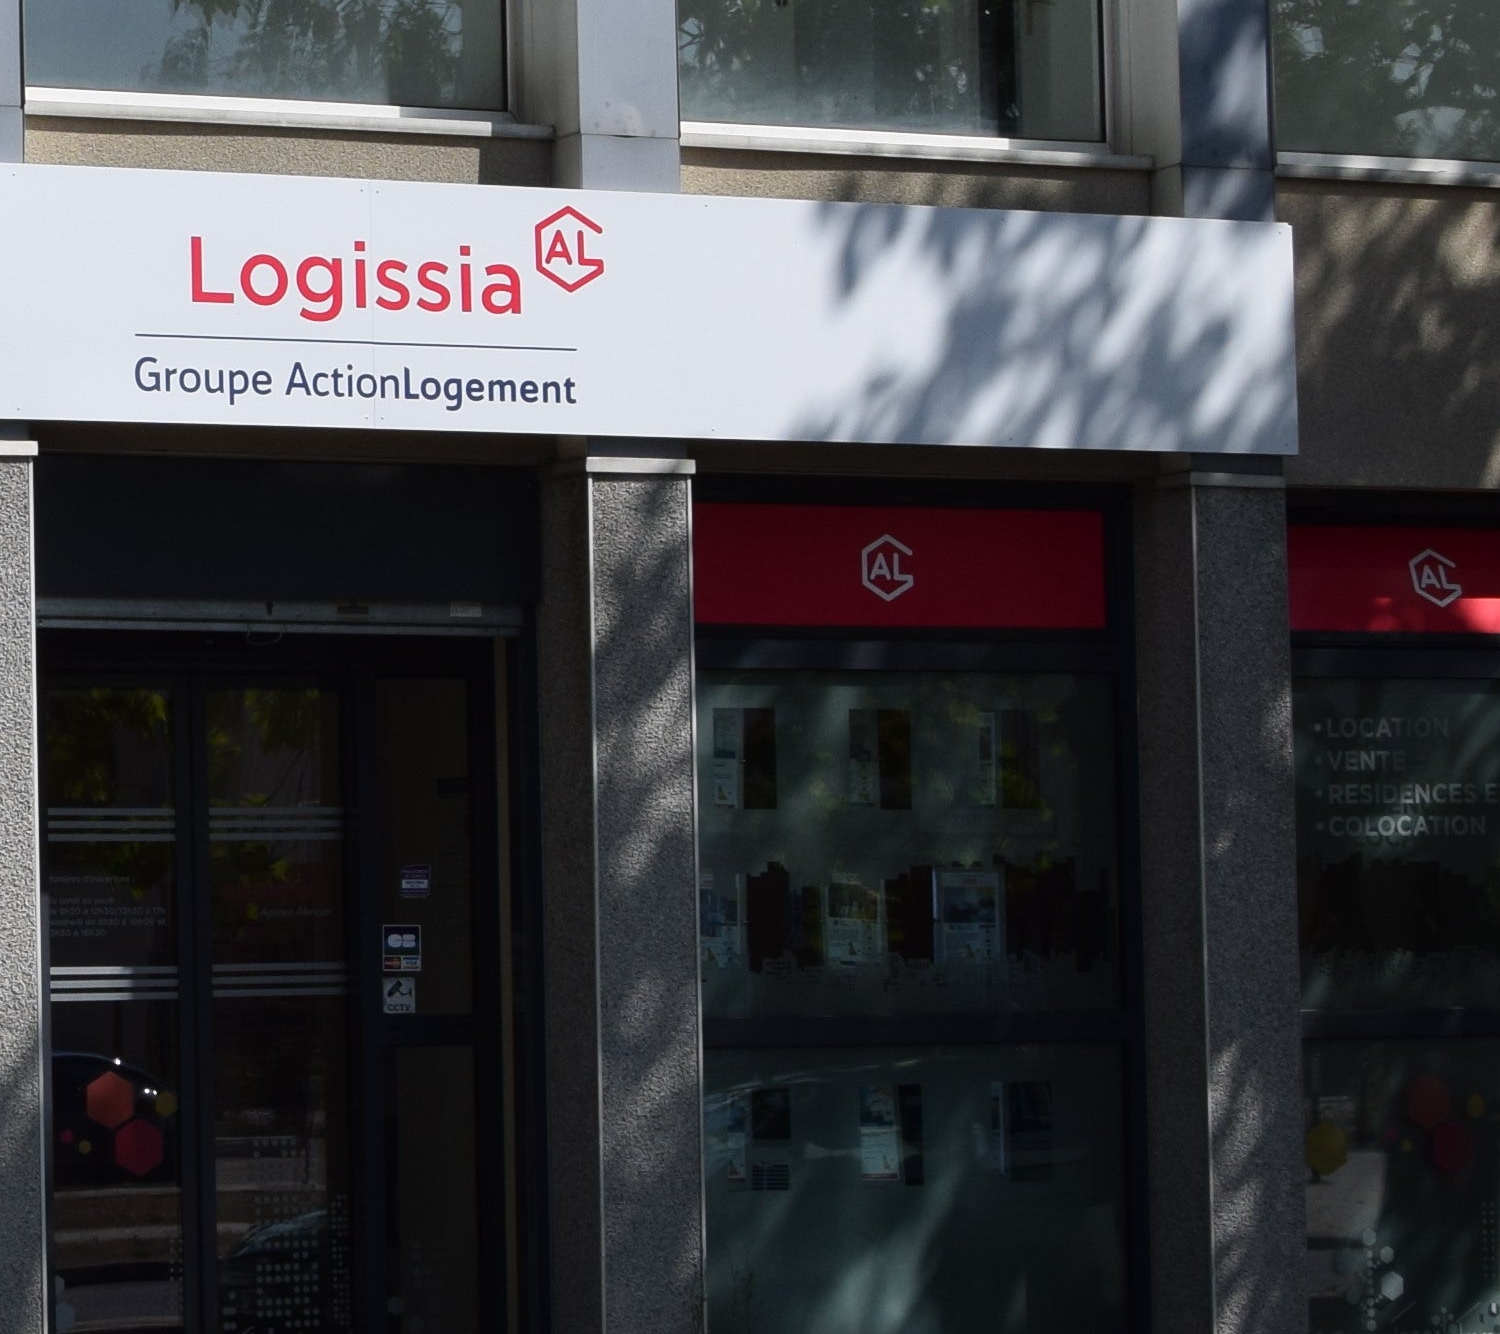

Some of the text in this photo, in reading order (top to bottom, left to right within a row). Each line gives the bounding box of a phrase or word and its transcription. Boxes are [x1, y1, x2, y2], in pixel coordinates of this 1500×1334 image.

[190, 235, 523, 322] Logissia
[134, 355, 577, 411] Groupe ActionLogement
[1326, 717, 1449, 739] LOCATION
[1327, 750, 1407, 772] VENTE
[1328, 782, 1478, 804] RESIDENCES
[1328, 815, 1487, 837] COLOCATION
[387, 1003, 411, 1012] CCTV
